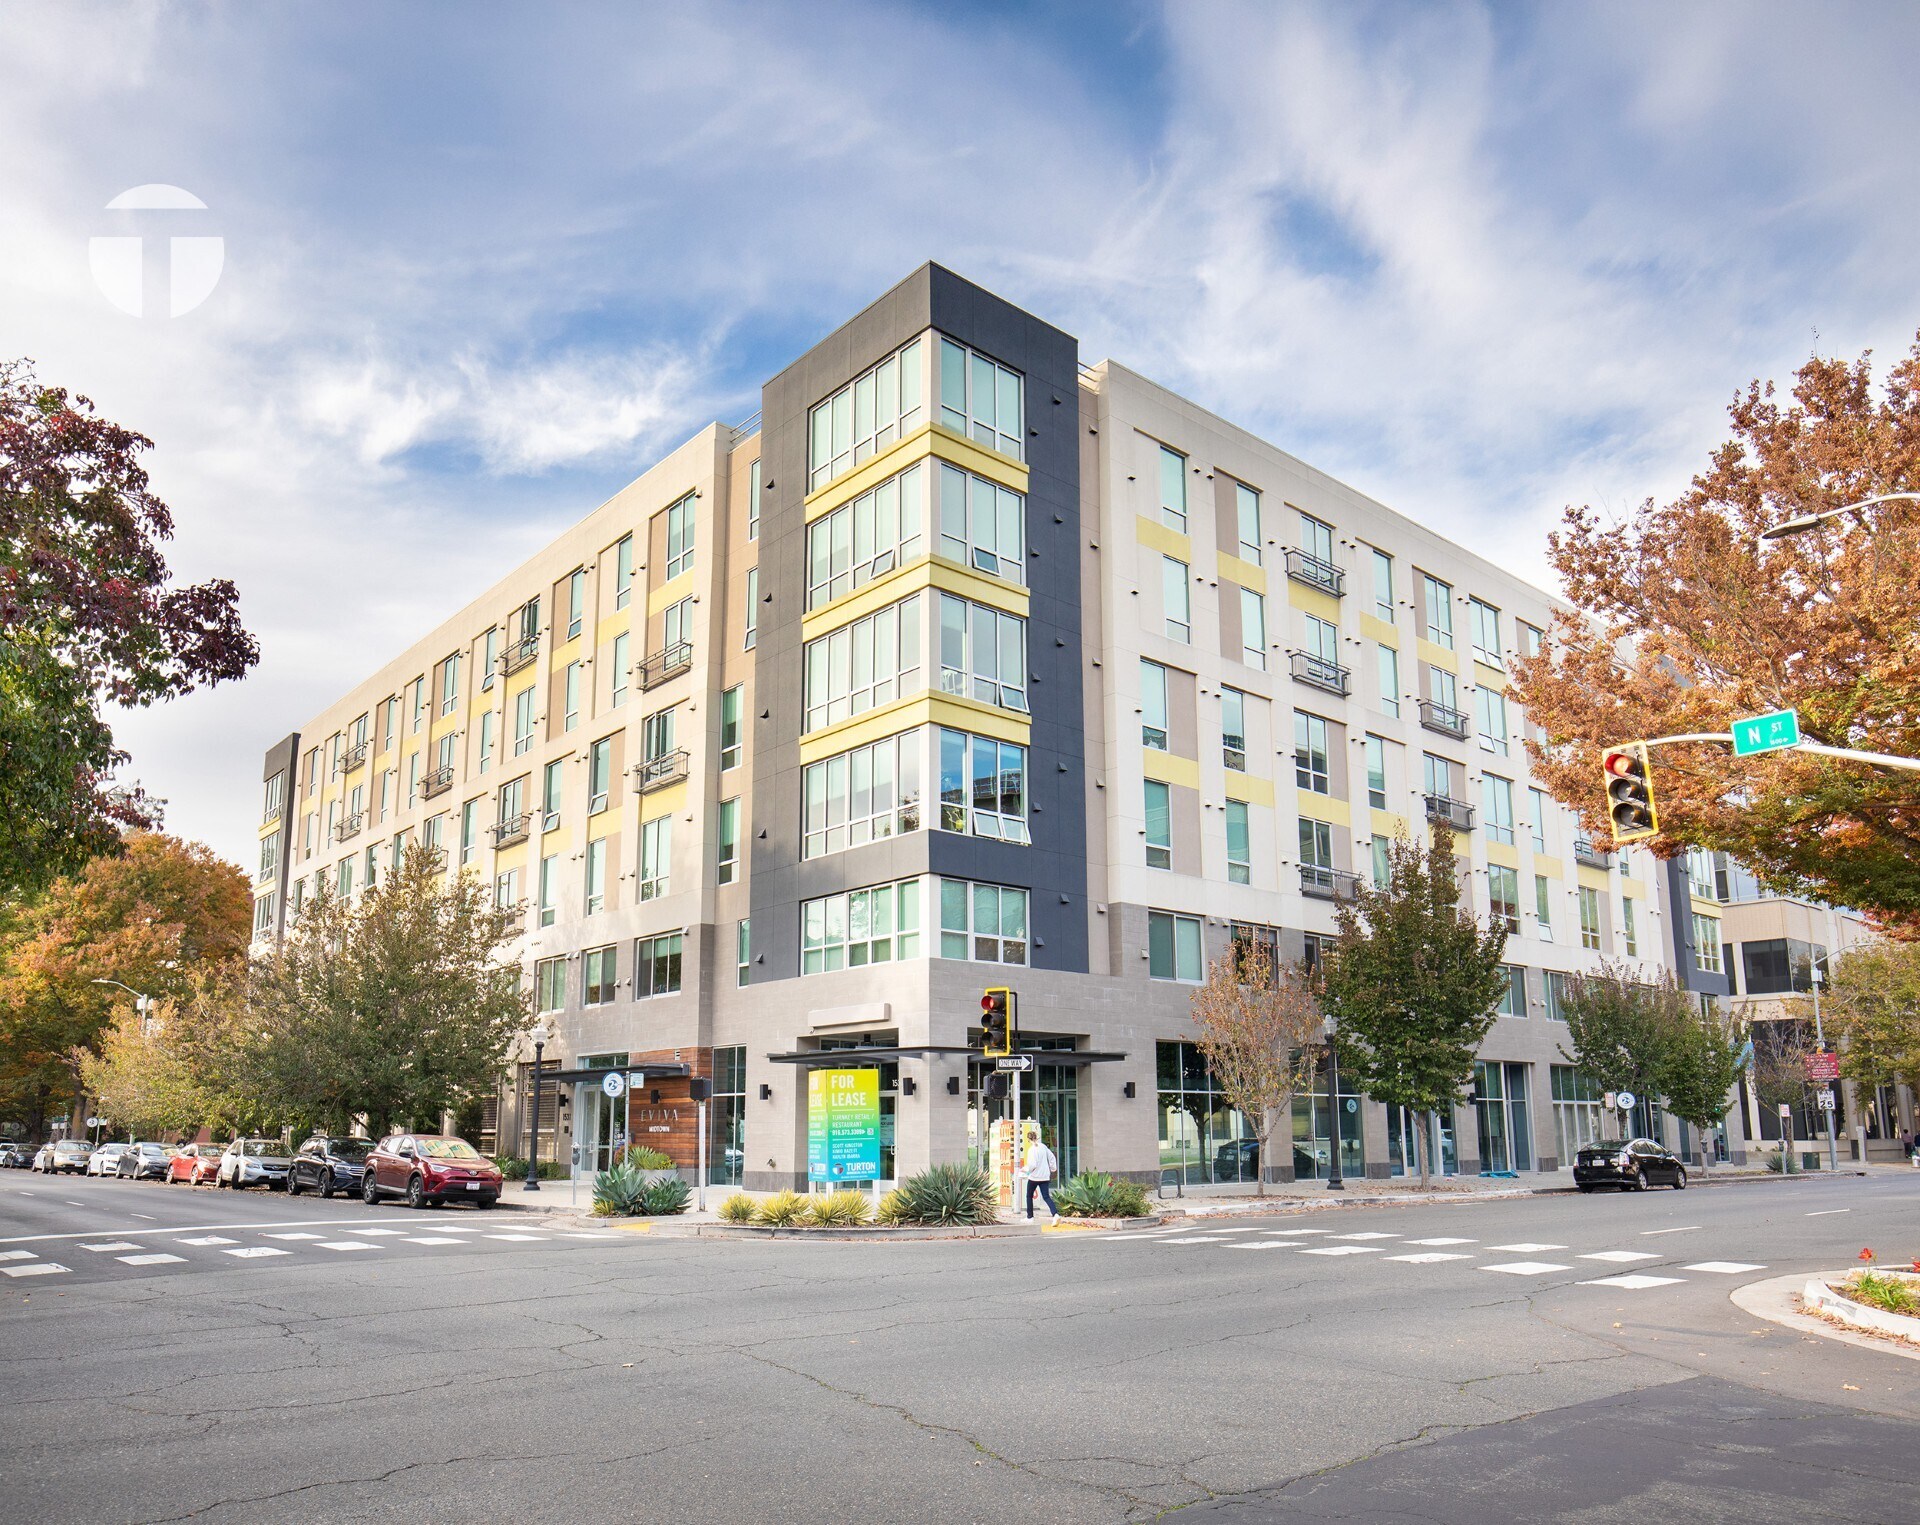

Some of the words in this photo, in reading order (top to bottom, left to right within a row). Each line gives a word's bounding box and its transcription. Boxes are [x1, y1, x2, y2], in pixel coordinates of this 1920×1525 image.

[1747, 726, 1761, 745] N
[1771, 722, 1783, 733] ST
[831, 1075, 854, 1088] FOR
[832, 1092, 867, 1106] LEASE
[1819, 1100, 1833, 1108] 25
[640, 1109, 679, 1122] EVIVA
[846, 1162, 876, 1171] TURTON
